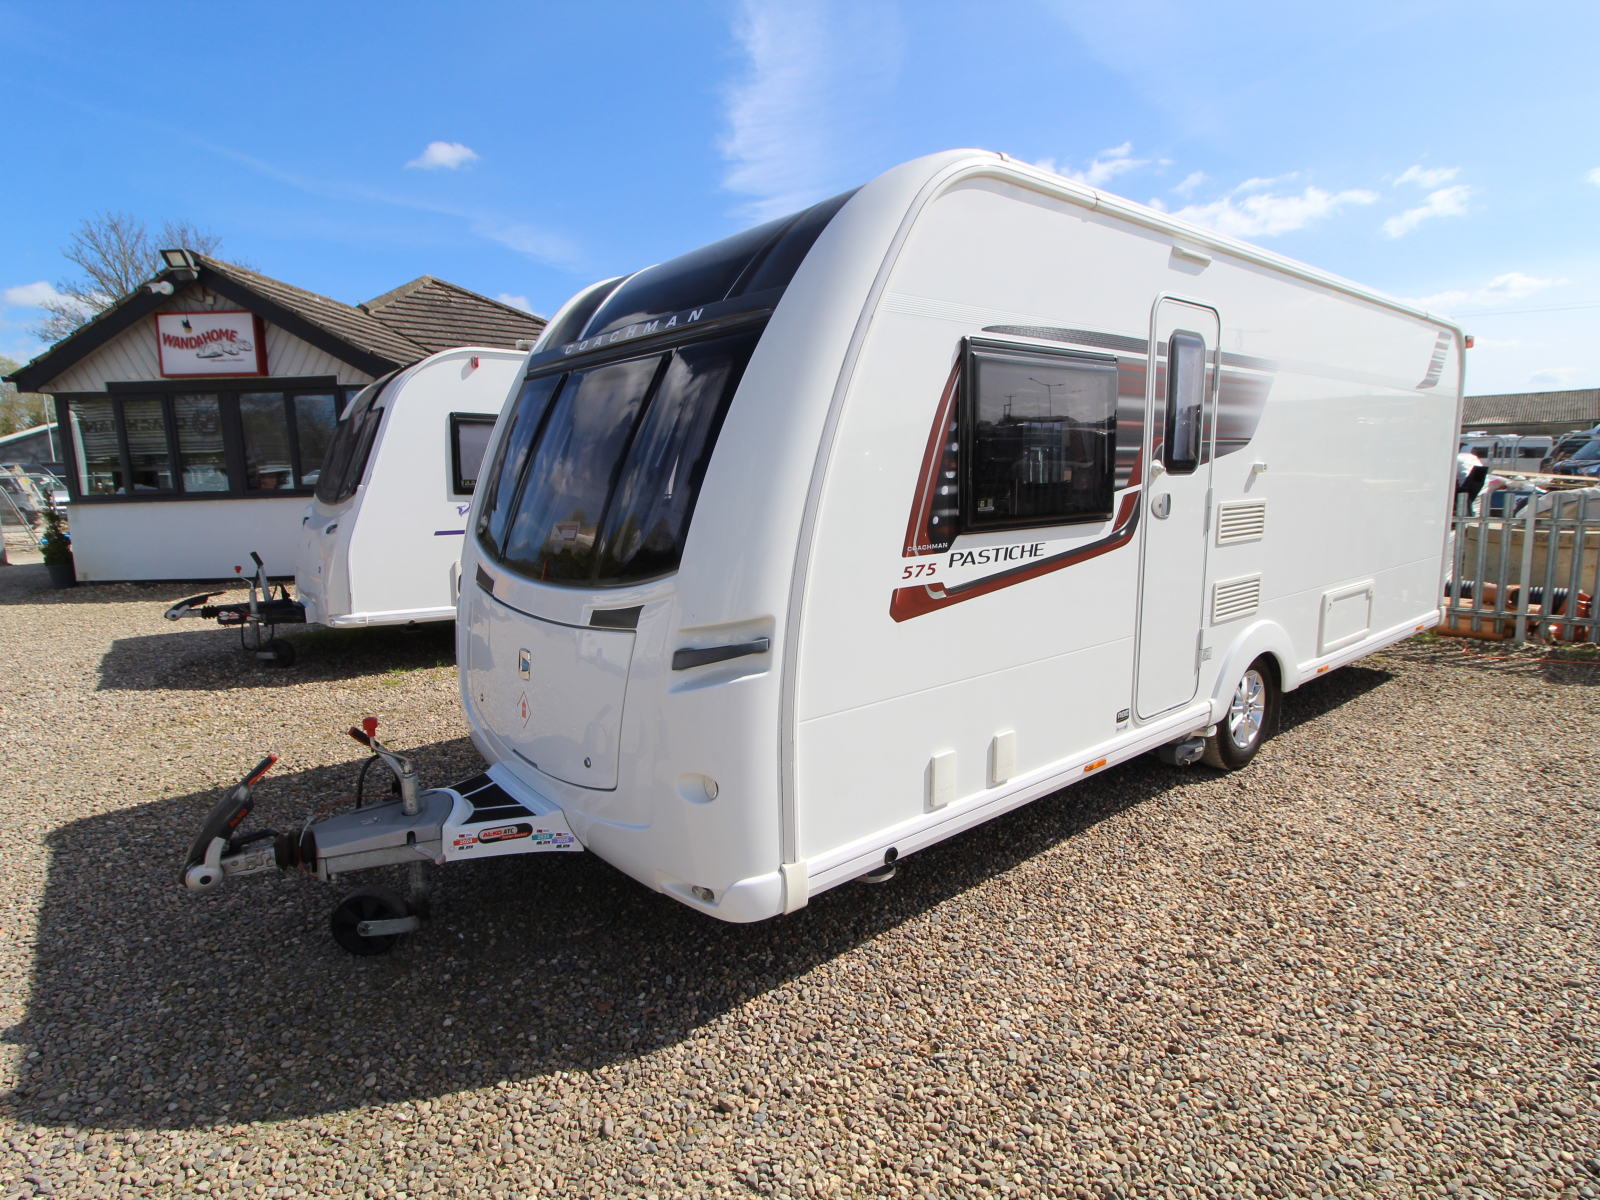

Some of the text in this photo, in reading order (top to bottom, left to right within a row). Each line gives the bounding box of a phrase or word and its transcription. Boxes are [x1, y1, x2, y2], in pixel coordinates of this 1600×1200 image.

[162, 328, 239, 350] WANDAHOME
[564, 308, 704, 355] COACHMAN
[907, 542, 948, 552] COACHMAN
[902, 542, 1046, 580] 575 PASTICHE
[503, 827, 515, 835] ATC
